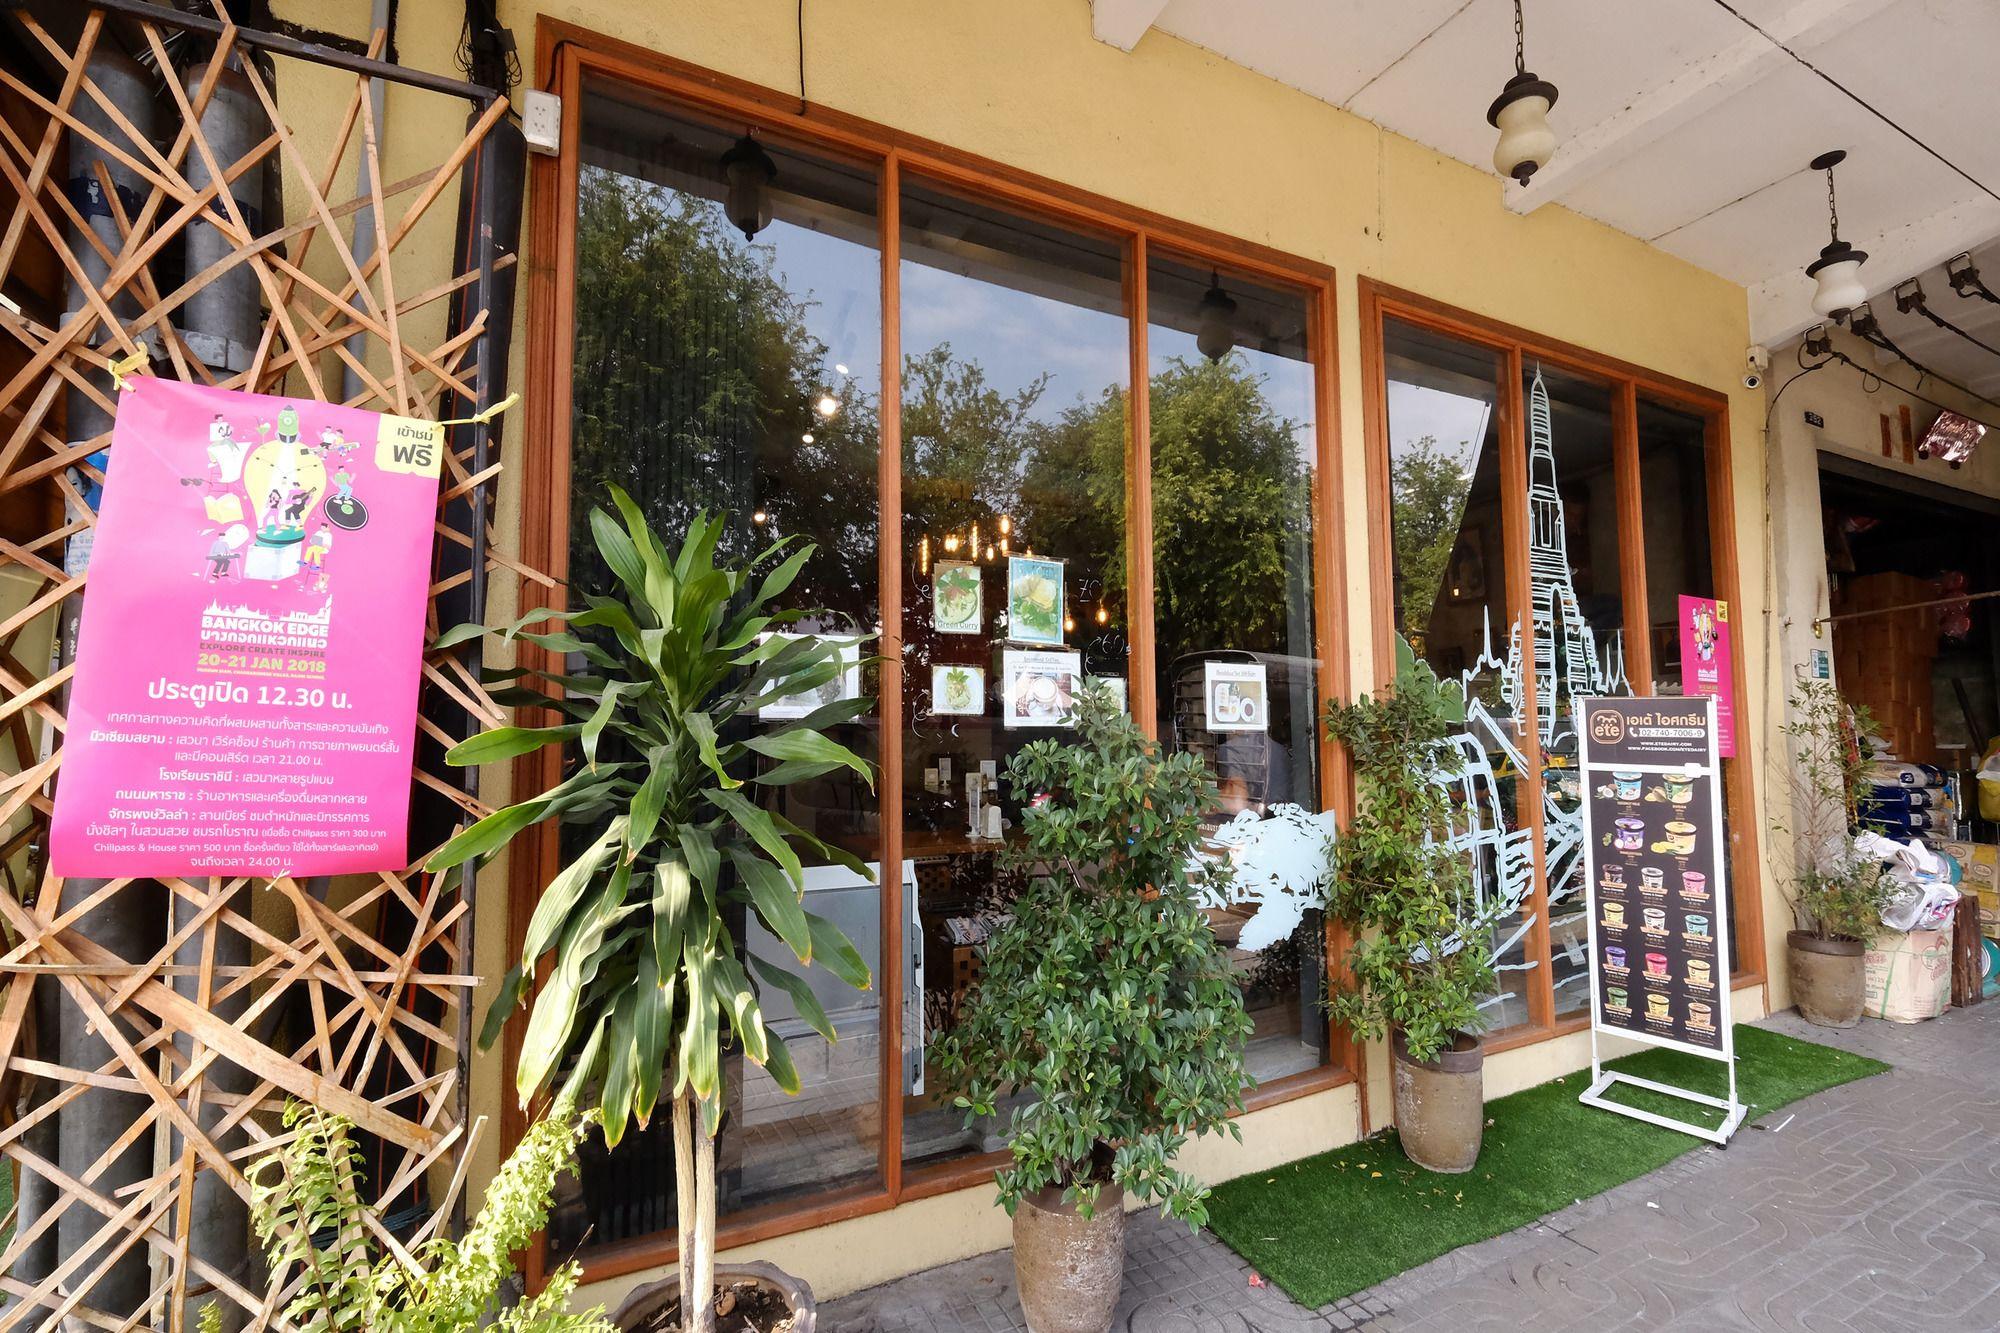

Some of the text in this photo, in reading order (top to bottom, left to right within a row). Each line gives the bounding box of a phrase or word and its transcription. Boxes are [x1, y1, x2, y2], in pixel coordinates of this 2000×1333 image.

[397, 425, 433, 441] เข้าชม
[393, 444, 433, 467] ฟรี
[201, 615, 329, 638] BANGKOK EDGE
[937, 620, 979, 631] Green Curry
[199, 642, 326, 658] EXPLORE CREATE INSPIRE
[198, 653, 327, 673] 20-21 JAN 2018
[148, 677, 353, 709] ประตูเปิด 12.30 น.
[1626, 712, 1706, 726] เอเต้ ไอศกรีม
[176, 735, 208, 746] เสวนา
[262, 736, 295, 749] ร้านค้า
[253, 754, 275, 764] เวลา
[278, 755, 310, 765] 21.00
[313, 757, 323, 766] น.
[159, 767, 232, 782] โรงเรียนราชินี
[115, 789, 186, 801] ถนนมหาราช
[199, 809, 247, 821] ลานเบียร์
[131, 822, 189, 836] ในสวนสวย
[352, 830, 369, 838] 300
[138, 843, 146, 852] &
[148, 843, 177, 852] House
[203, 844, 221, 852] 500
[191, 856, 294, 867] จนถึงเวลา 24.00 น.
